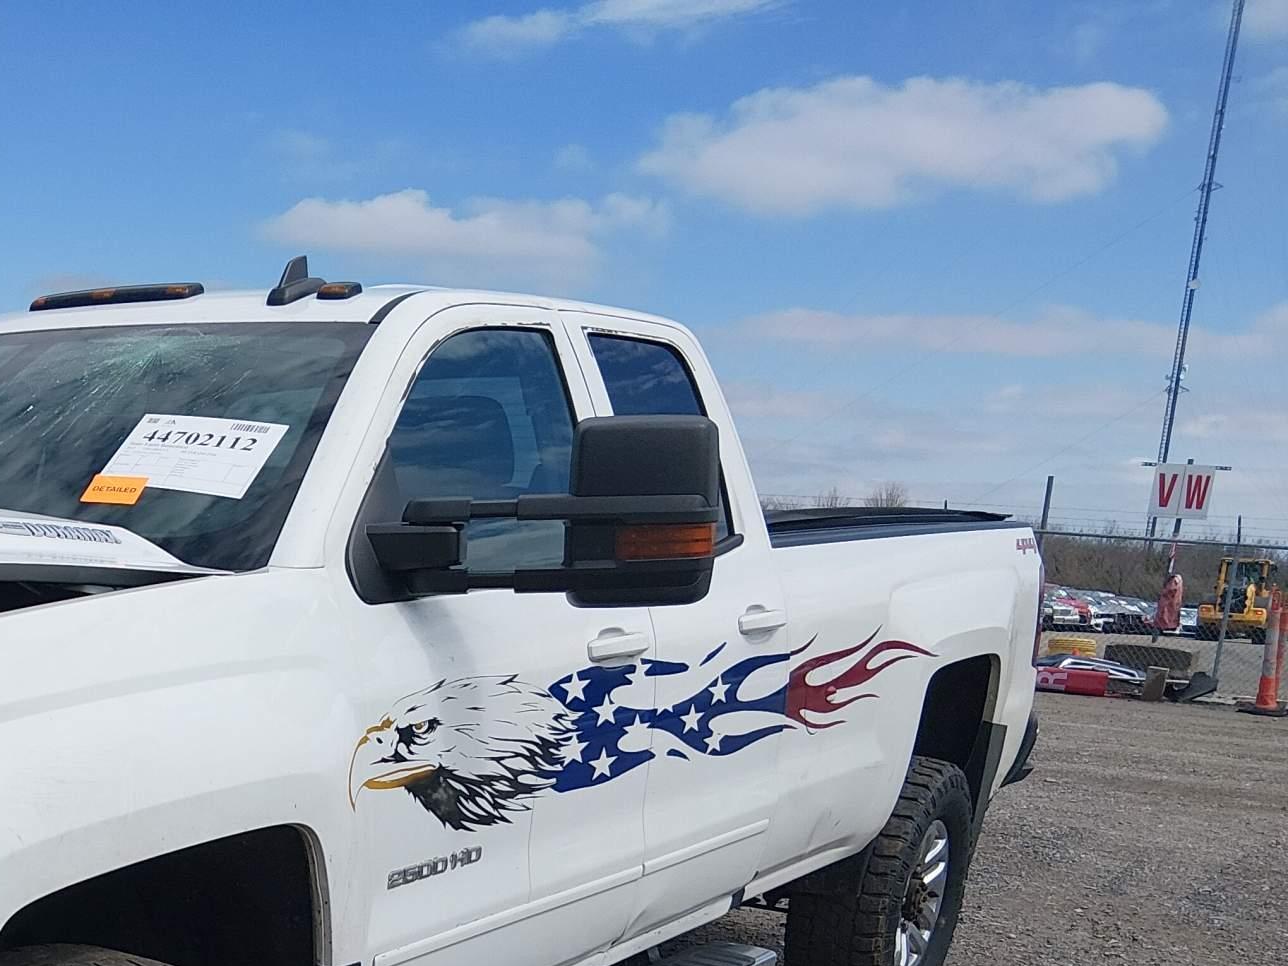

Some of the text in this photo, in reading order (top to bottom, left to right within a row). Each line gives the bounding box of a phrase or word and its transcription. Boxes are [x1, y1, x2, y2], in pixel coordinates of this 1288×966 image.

[143, 429, 258, 451] 44702112
[92, 485, 137, 493] DETAILED
[1159, 472, 1211, 510] V W
[387, 846, 482, 890] 2500 HD
